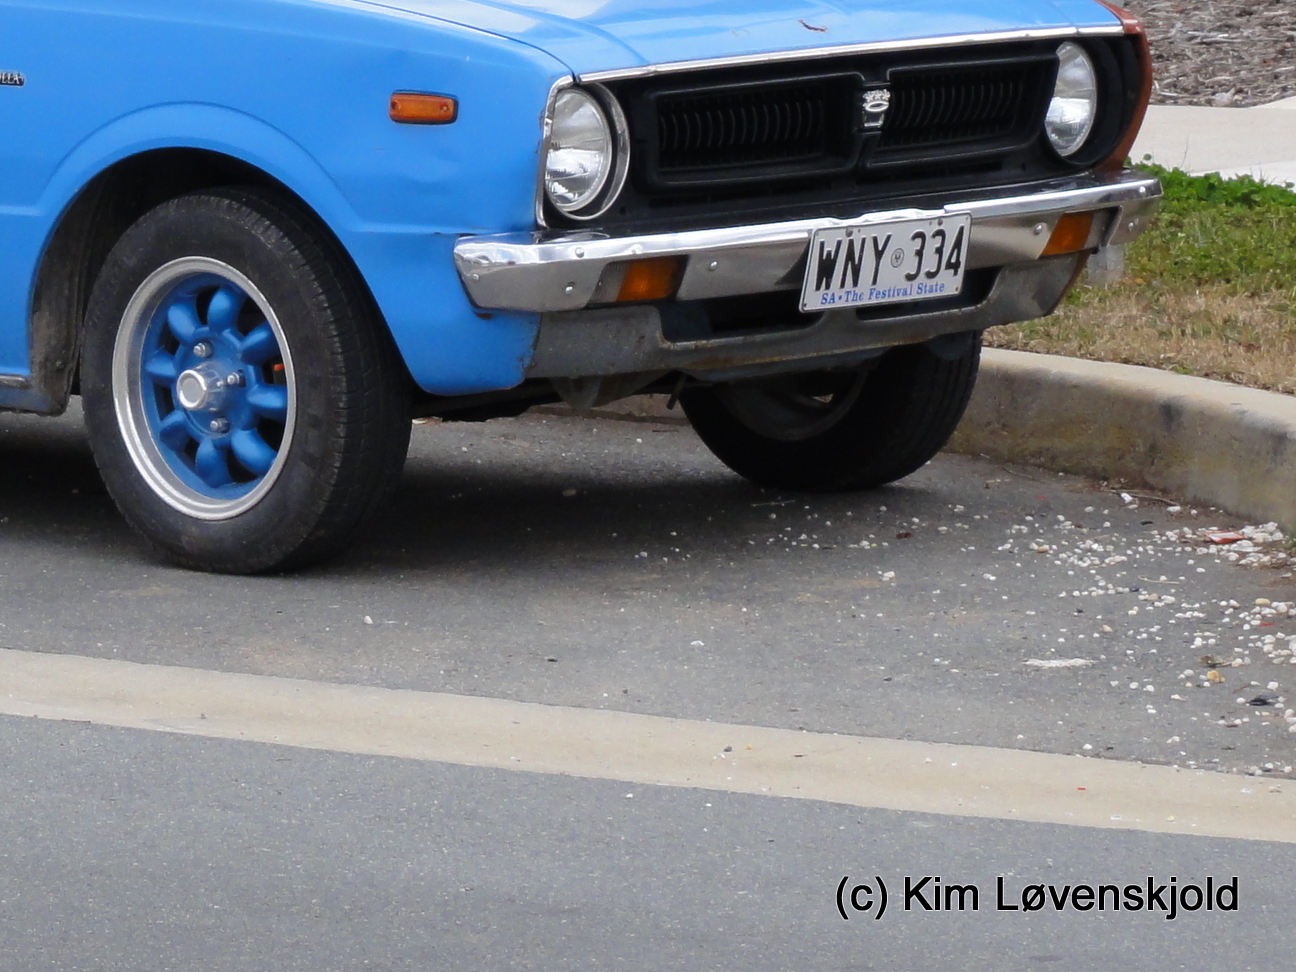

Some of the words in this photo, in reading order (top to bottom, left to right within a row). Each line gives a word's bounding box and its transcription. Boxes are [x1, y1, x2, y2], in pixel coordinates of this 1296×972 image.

[815, 233, 892, 291] WNY
[904, 225, 965, 281] 334
[868, 283, 913, 300] Festival
[916, 281, 945, 294] State
